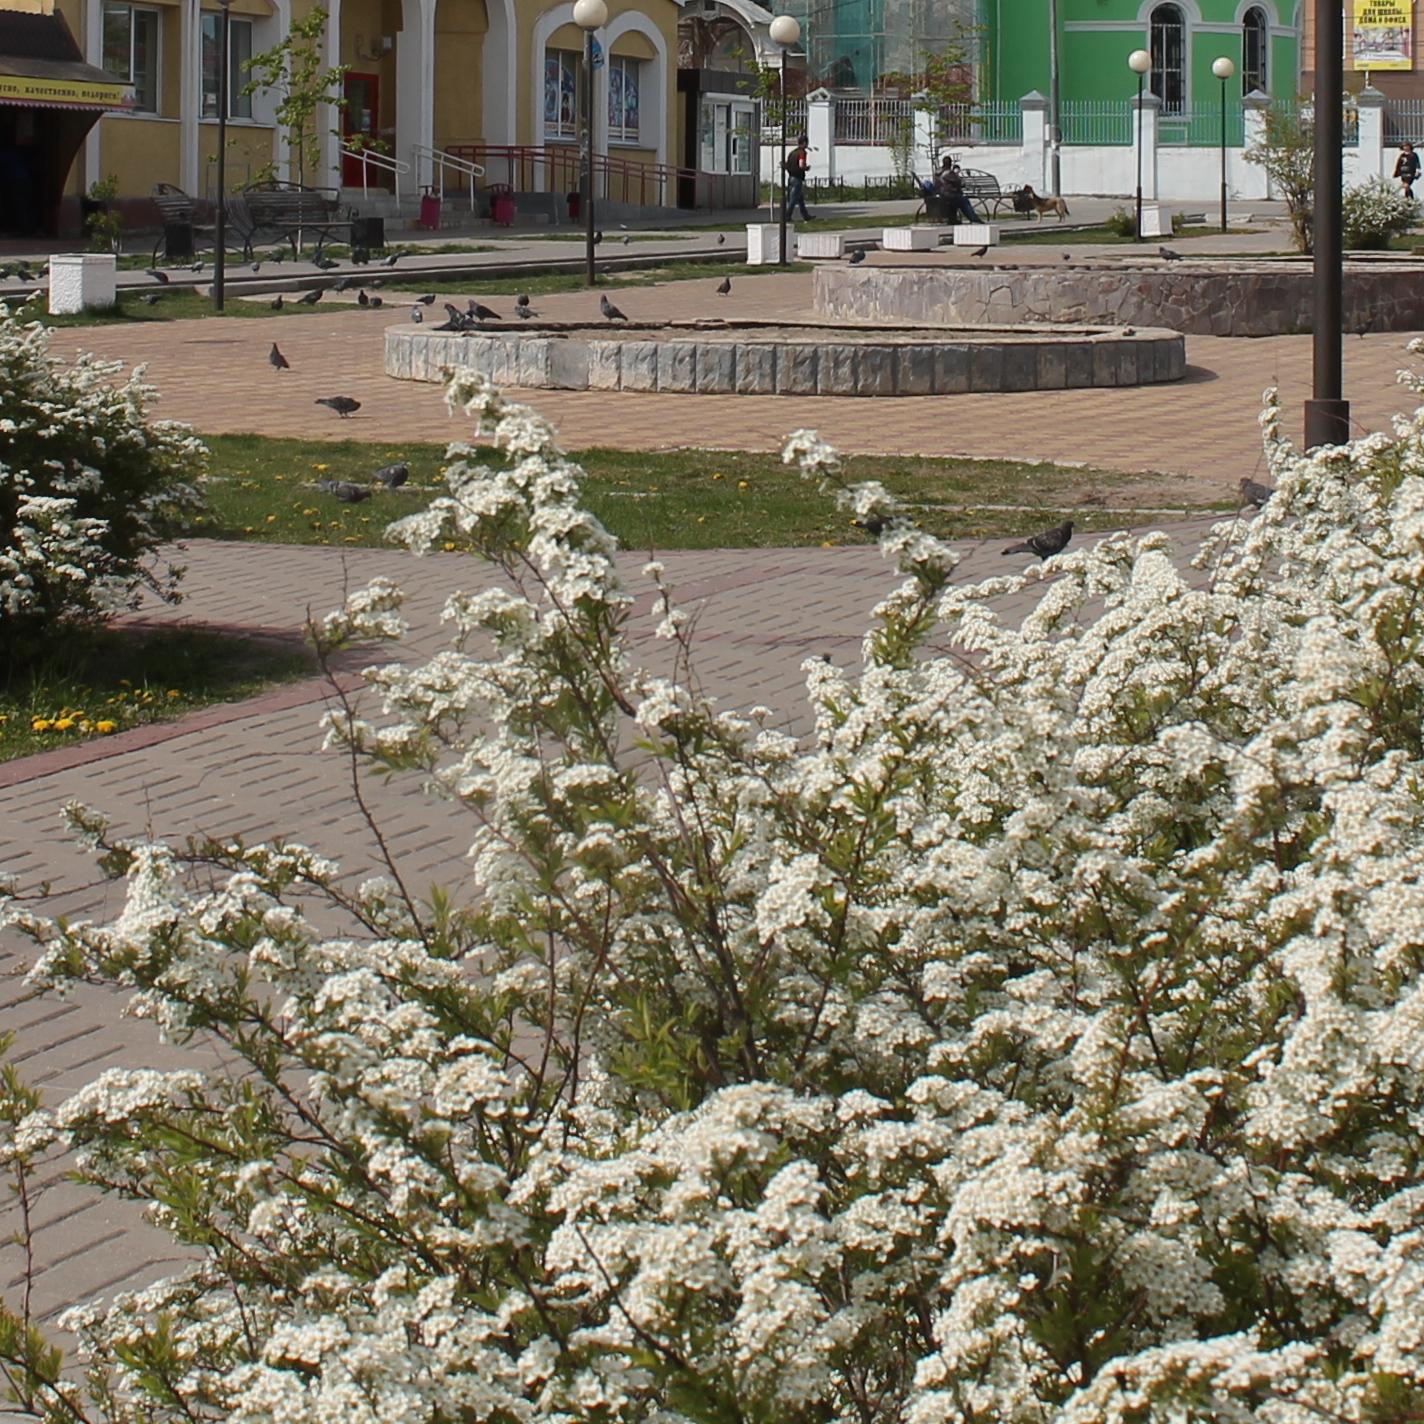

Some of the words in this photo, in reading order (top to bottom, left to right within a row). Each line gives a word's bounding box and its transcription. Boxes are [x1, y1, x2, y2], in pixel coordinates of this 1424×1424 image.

[1369, 0, 1396, 7] ТОВАРЫ
[1358, 16, 1377, 25] ДОМА
[1383, 16, 1407, 24] ОФИСА
